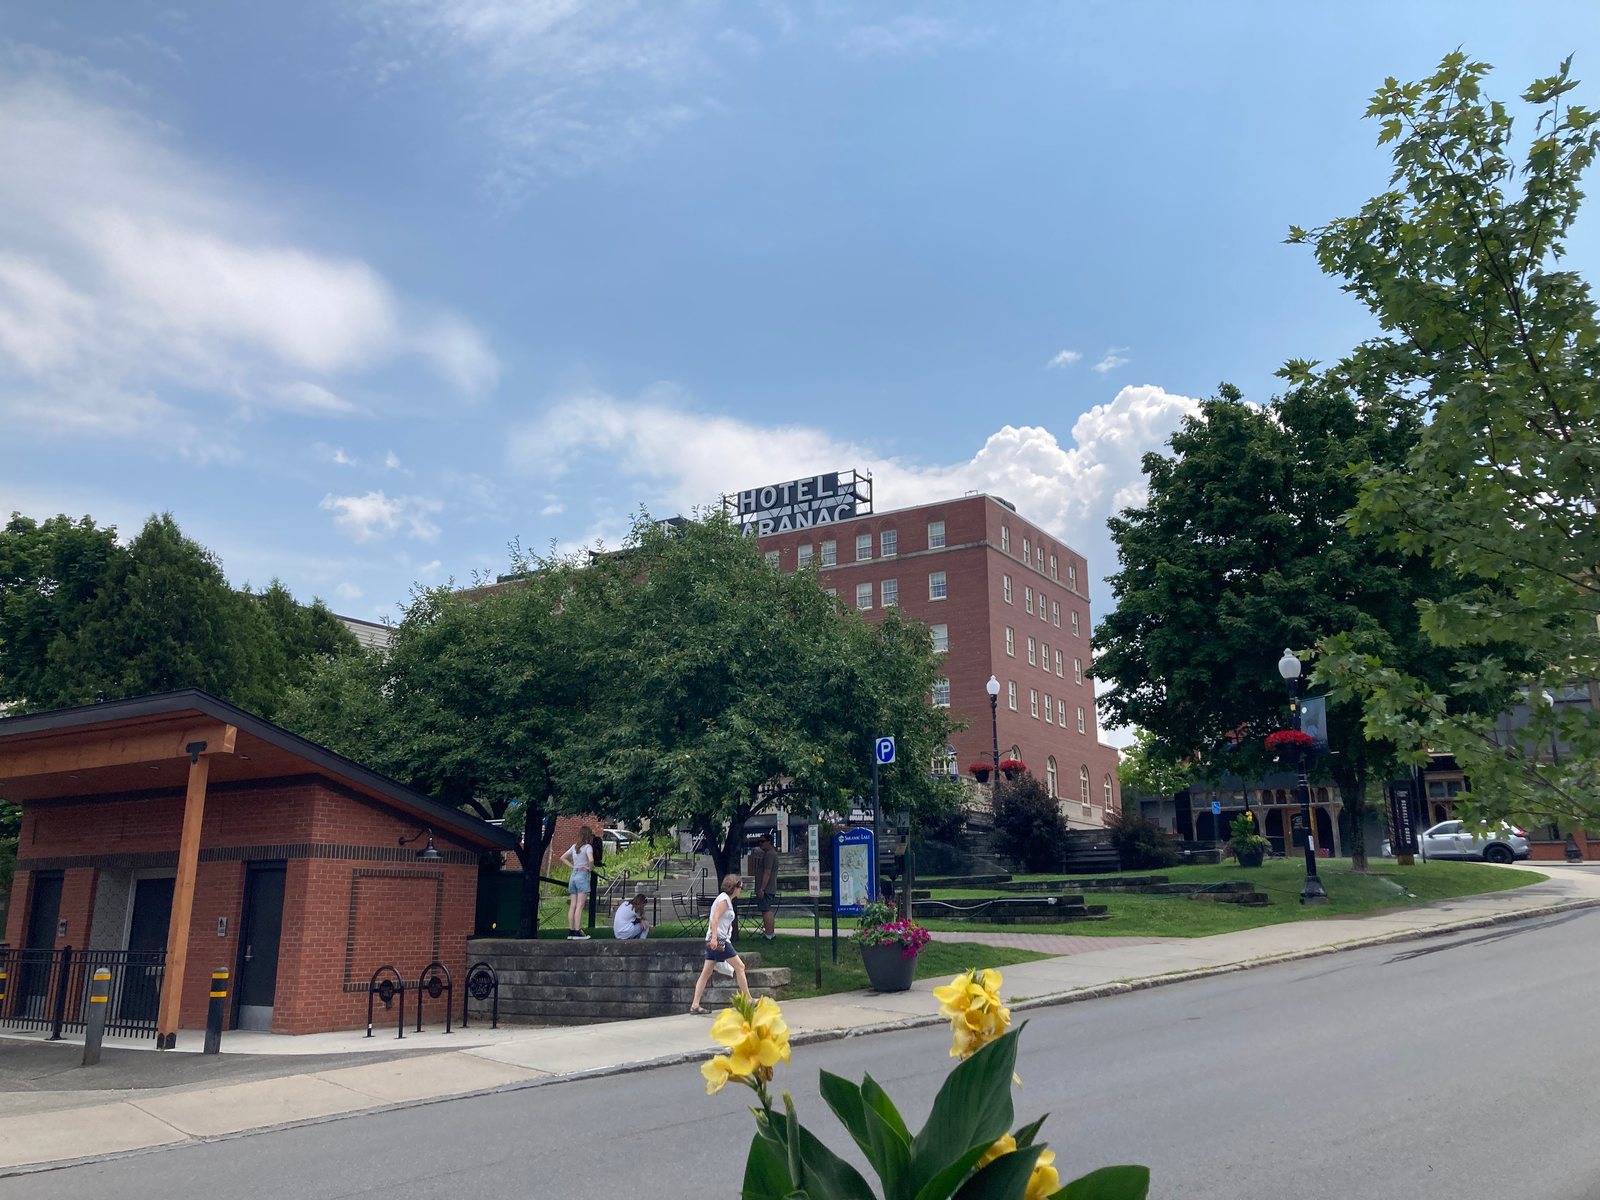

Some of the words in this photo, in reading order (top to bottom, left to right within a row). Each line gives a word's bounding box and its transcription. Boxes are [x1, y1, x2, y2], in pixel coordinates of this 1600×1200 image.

[739, 475, 834, 513] HOTEL
[741, 504, 851, 538] ARANAC
[880, 742, 891, 760] P
